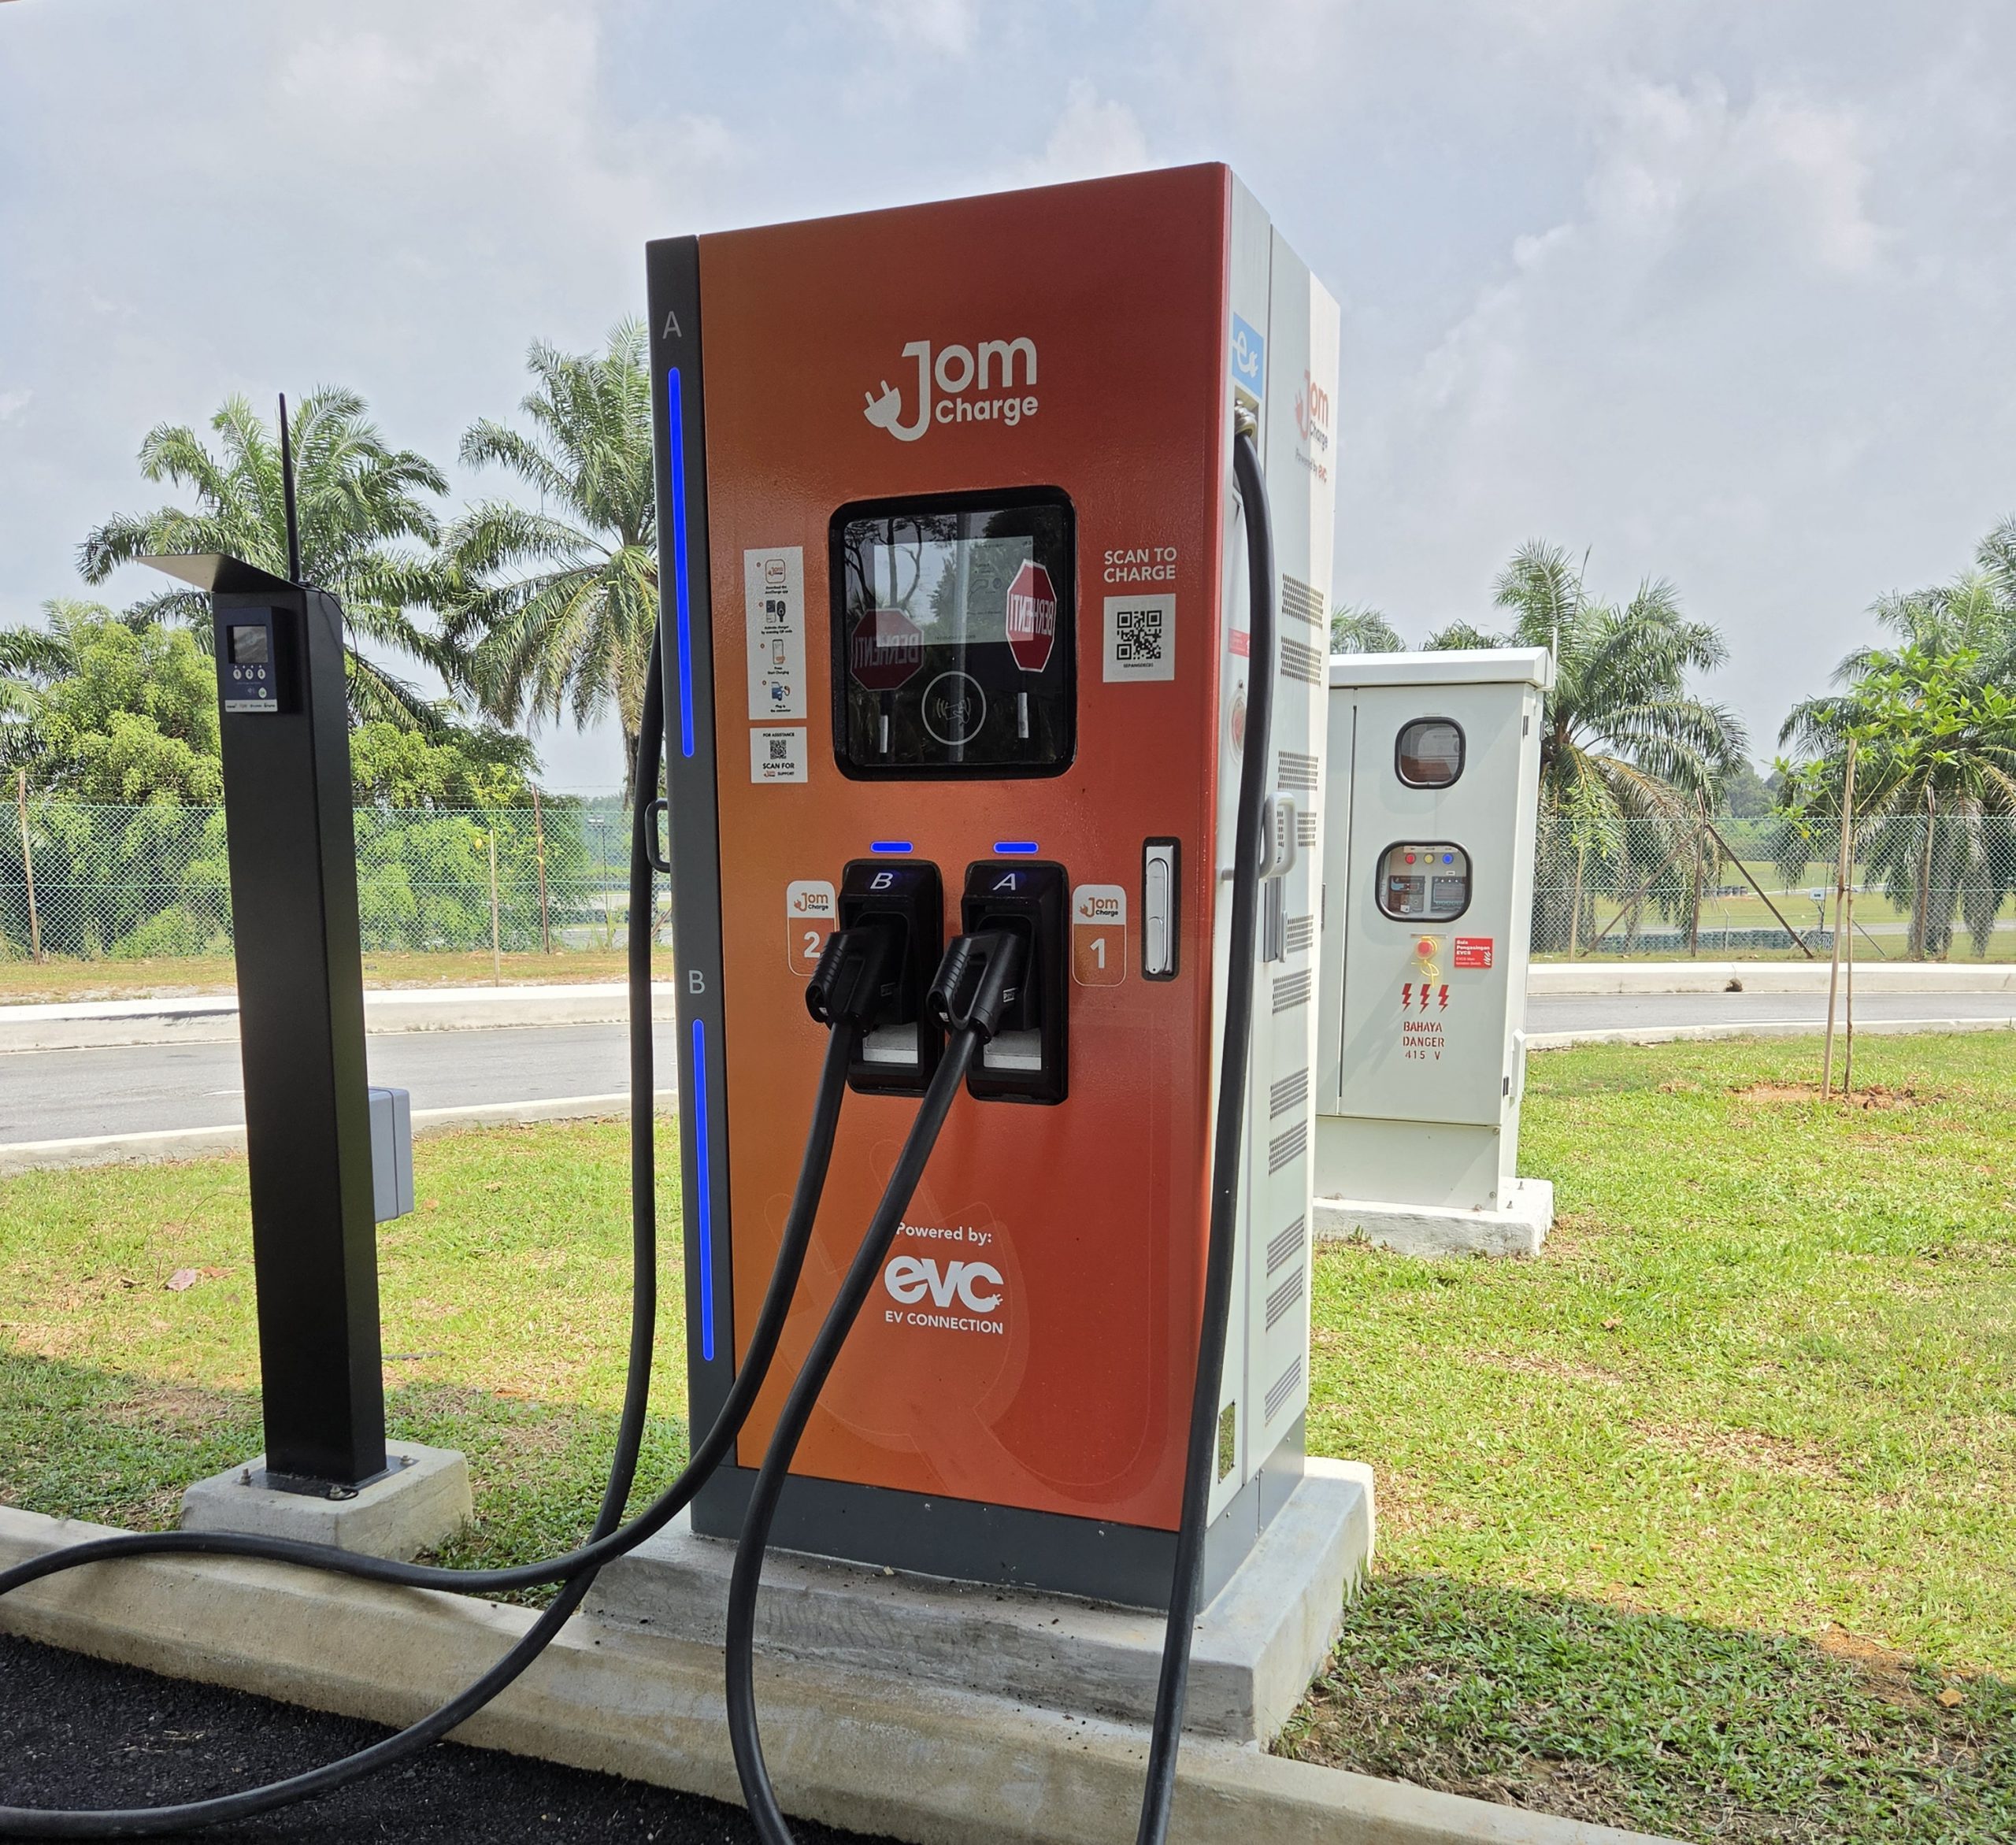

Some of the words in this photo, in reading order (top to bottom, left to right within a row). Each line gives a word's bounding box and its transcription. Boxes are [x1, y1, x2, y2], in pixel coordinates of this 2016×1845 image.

[662, 310, 682, 339] A
[864, 337, 1037, 442] Jom
[1104, 549, 1149, 565] SCAN
[1154, 546, 1177, 562] TO
[1103, 565, 1176, 584] CHARGE
[869, 872, 894, 890] B
[992, 872, 1016, 891] A
[794, 892, 828, 912] Jom
[1080, 897, 1118, 917] Jom
[804, 931, 821, 958] 2
[1090, 938, 1105, 969] 1
[688, 969, 706, 995] B
[1403, 1021, 1442, 1032] BAHAYA
[1403, 1036, 1444, 1047] DANGER
[1405, 1050, 1425, 1060] 415
[1434, 1050, 1441, 1060] V
[896, 1221, 962, 1240] Powered
[969, 1226, 992, 1246] by:
[884, 1255, 1004, 1313] evc
[885, 1310, 903, 1323] EV
[906, 1313, 1003, 1334] CONNECTION
